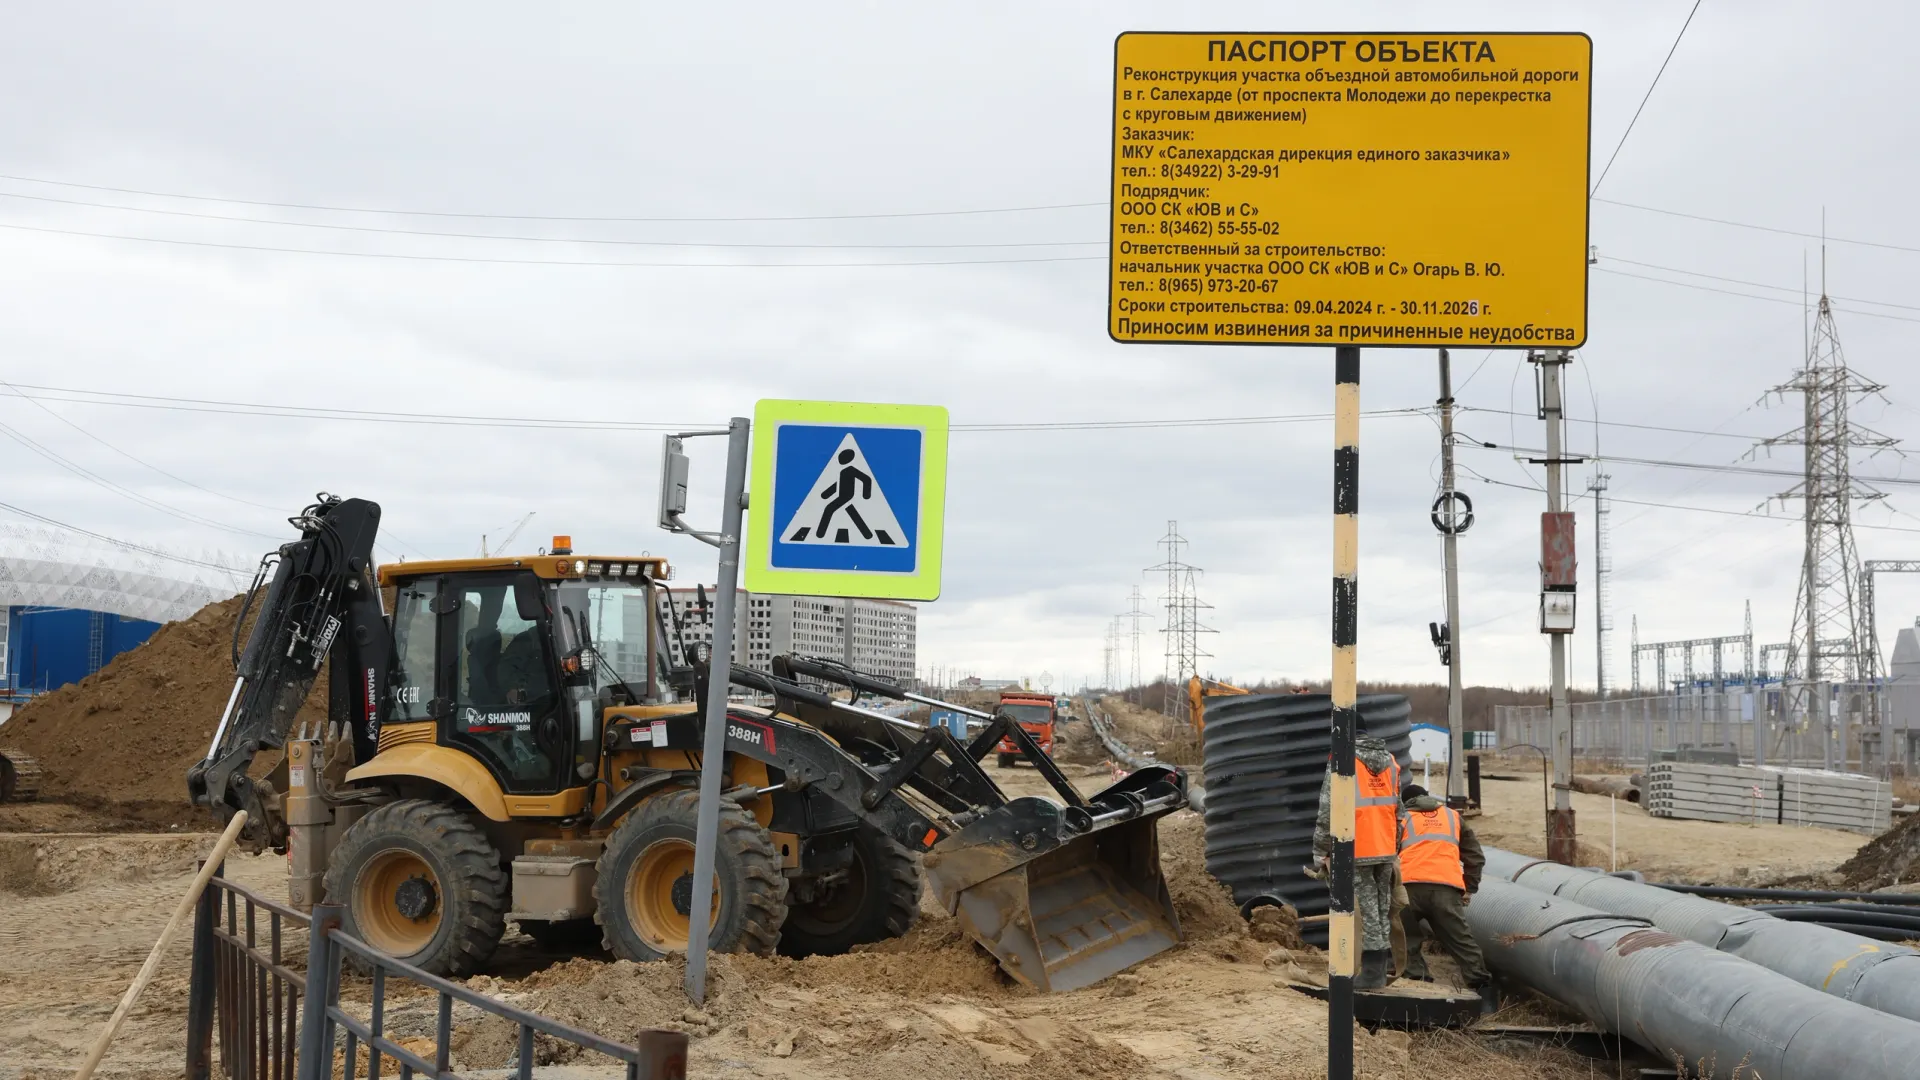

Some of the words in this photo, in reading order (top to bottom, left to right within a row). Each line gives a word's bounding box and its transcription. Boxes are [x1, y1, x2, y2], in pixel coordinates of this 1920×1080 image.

[1209, 40, 1346, 62] ПАСПОРТ
[1356, 41, 1495, 62] ОБЪЕКТА
[1124, 67, 1237, 84] Реконструкция
[1242, 72, 1300, 85] участка
[1306, 68, 1389, 84] объездной
[1395, 68, 1518, 82] автомобильной
[1523, 71, 1578, 84] дороги
[1124, 90, 1132, 100] в
[1137, 90, 1144, 100] г.
[1151, 87, 1232, 104] Салехарде
[1237, 88, 1258, 104] (от
[1264, 91, 1341, 104] проспекта
[1347, 88, 1426, 104] Молодежи
[1431, 92, 1450, 104] до
[1456, 92, 1551, 105] перекрестка
[1123, 110, 1130, 120] с
[1136, 110, 1210, 123] круговым
[1214, 108, 1306, 124] движением)
[1123, 127, 1193, 140] Заказчик:
[1123, 145, 1154, 158] МКУ
[1159, 146, 1274, 163] «Салехардская
[1279, 150, 1352, 163] дирекция
[1357, 150, 1420, 162] единого
[1425, 150, 1511, 160] заказчика»
[1121, 166, 1156, 177] тел.:
[1161, 164, 1222, 181] 8(34922)
[1228, 165, 1278, 178] 3-29-91
[1122, 184, 1209, 200] Подрядчик:
[1121, 202, 1156, 215] ООО
[1161, 202, 1181, 215] СК
[1187, 203, 1220, 216] «ЮВ
[1226, 207, 1234, 216] и
[1240, 203, 1258, 216] С»
[1120, 223, 1155, 233] тел.:
[1160, 221, 1212, 237] 8(3462)
[1218, 221, 1279, 235] 55-55-02
[1120, 241, 1239, 255] Ответственный
[1245, 246, 1260, 255] за
[1265, 246, 1385, 259] строительство:
[1120, 263, 1200, 273] начальник
[1205, 264, 1263, 277] участка
[1268, 261, 1304, 274] ООО
[1309, 261, 1329, 275] СК
[1335, 261, 1369, 275] «ЮВ
[1375, 265, 1383, 275] и
[1389, 262, 1408, 275] С»
[1414, 262, 1459, 279] Огарь
[1465, 263, 1479, 276] В.
[1486, 263, 1504, 276] Ю.
[1119, 280, 1154, 291] тел.:
[1159, 278, 1203, 295] 8(965)
[1208, 279, 1278, 293] 973-20-67
[1119, 298, 1164, 314] Сроки
[1170, 302, 1288, 315] строительства:
[1294, 300, 1372, 314] 09.04.2024
[1377, 304, 1385, 314] г.
[1401, 301, 1477, 315] 30.11.2026
[1483, 305, 1491, 315] г.
[1119, 318, 1208, 337] Приносим
[1215, 324, 1309, 336] извинения
[1315, 325, 1332, 337] за
[1339, 325, 1463, 340] причиненные
[1470, 324, 1575, 342] неудобства
[367, 667, 377, 721] SHANMON
[487, 712, 531, 724] SHANMON
[728, 725, 761, 744] 388H
